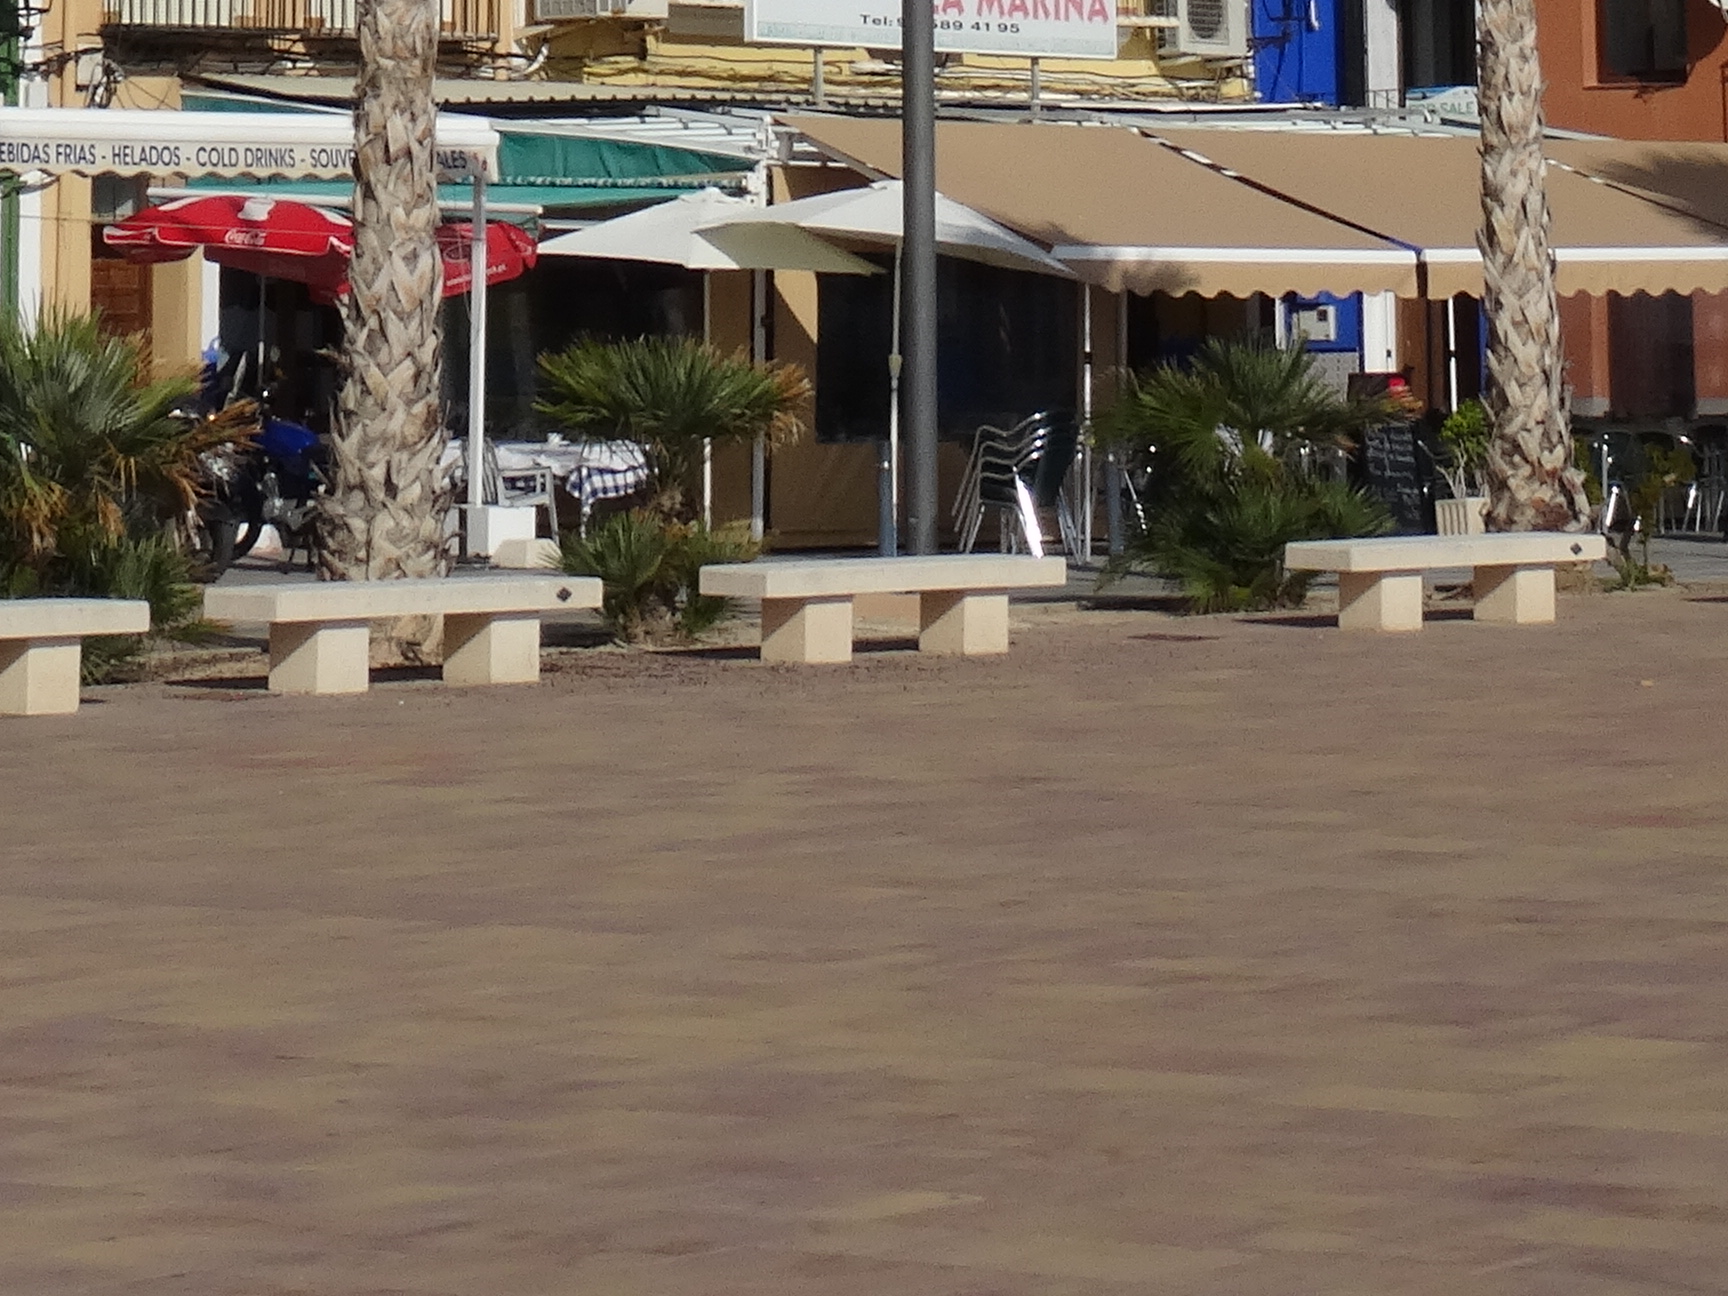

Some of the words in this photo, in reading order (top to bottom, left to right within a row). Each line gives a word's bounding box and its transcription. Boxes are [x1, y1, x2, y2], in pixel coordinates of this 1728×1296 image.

[860, 13, 893, 27] Tel:
[970, 21, 990, 32] 41
[998, 22, 1020, 34] 95
[1440, 102, 1475, 115] SALE
[56, 143, 96, 165] FRIAS
[112, 145, 180, 167] HELADOS
[196, 147, 239, 168] COLD
[244, 147, 295, 169] DRINKS
